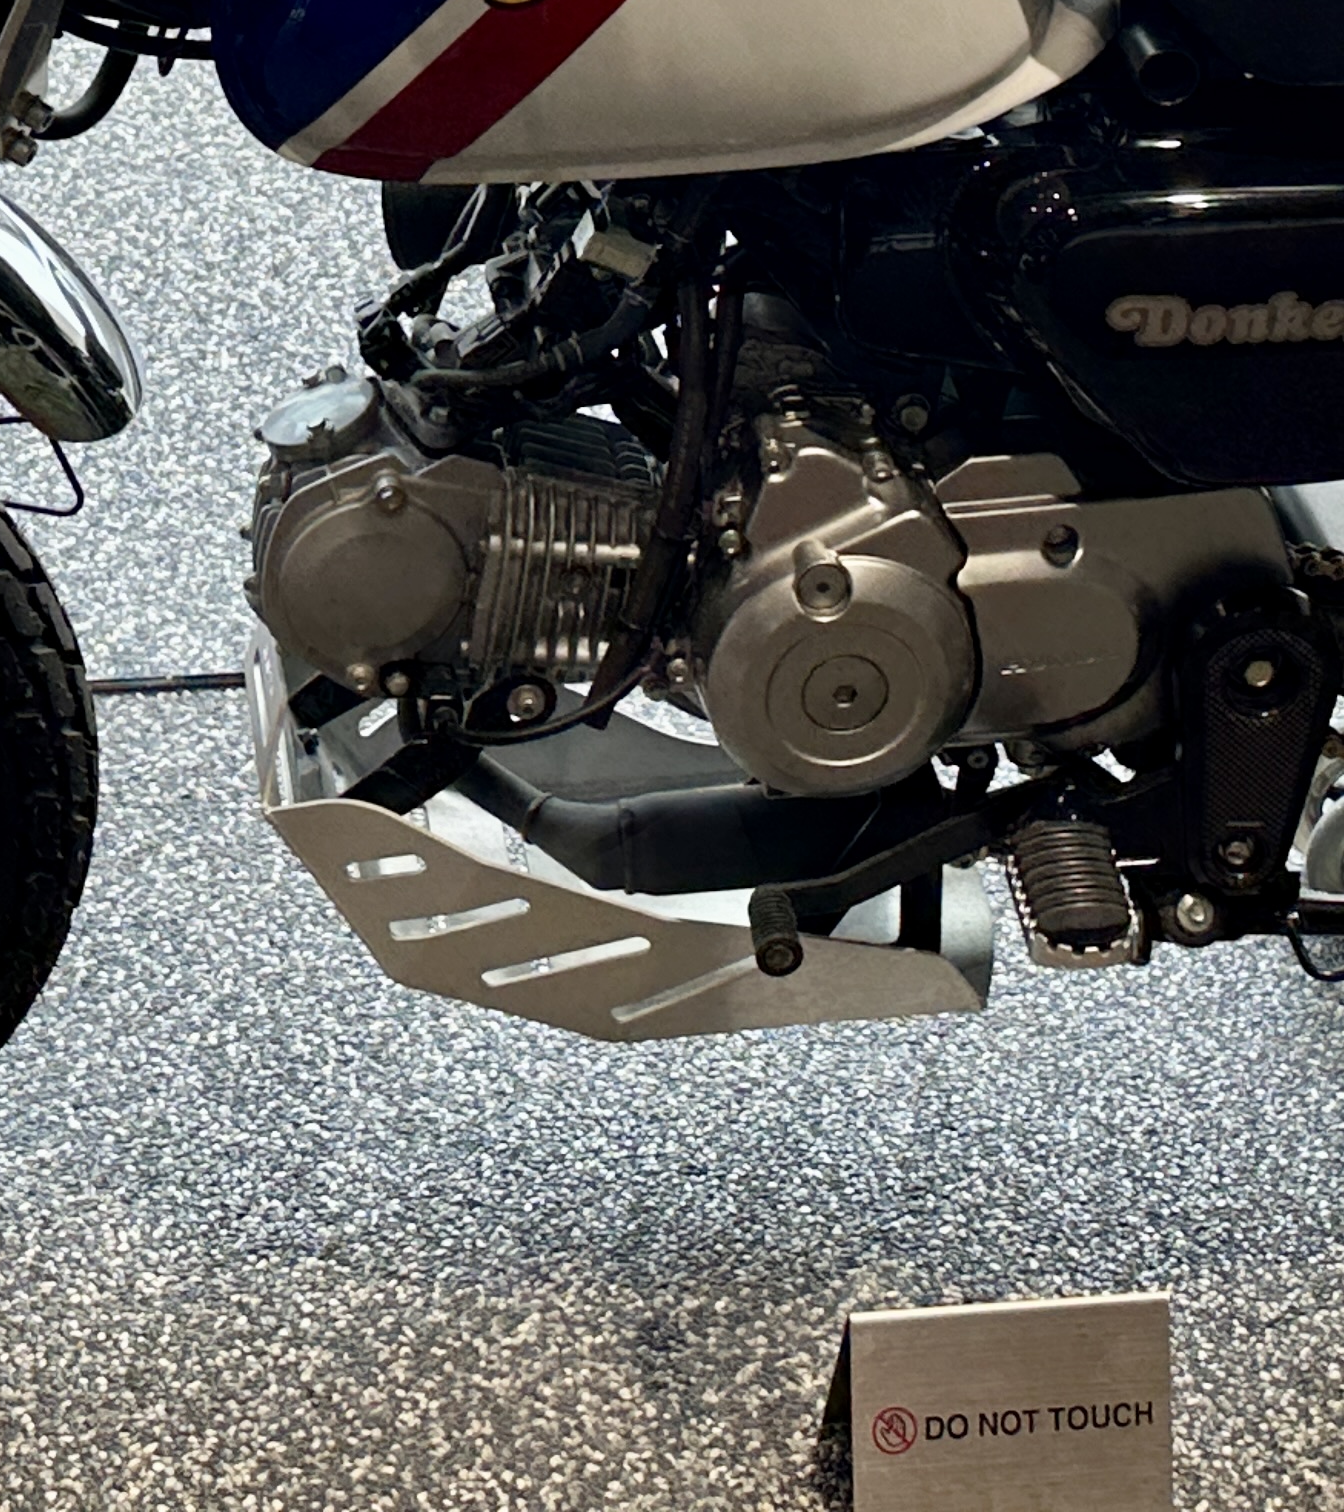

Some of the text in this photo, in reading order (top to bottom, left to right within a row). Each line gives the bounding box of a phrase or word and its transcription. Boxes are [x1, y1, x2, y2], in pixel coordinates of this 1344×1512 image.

[925, 1401, 1153, 1440] DO NOT TOUCH
